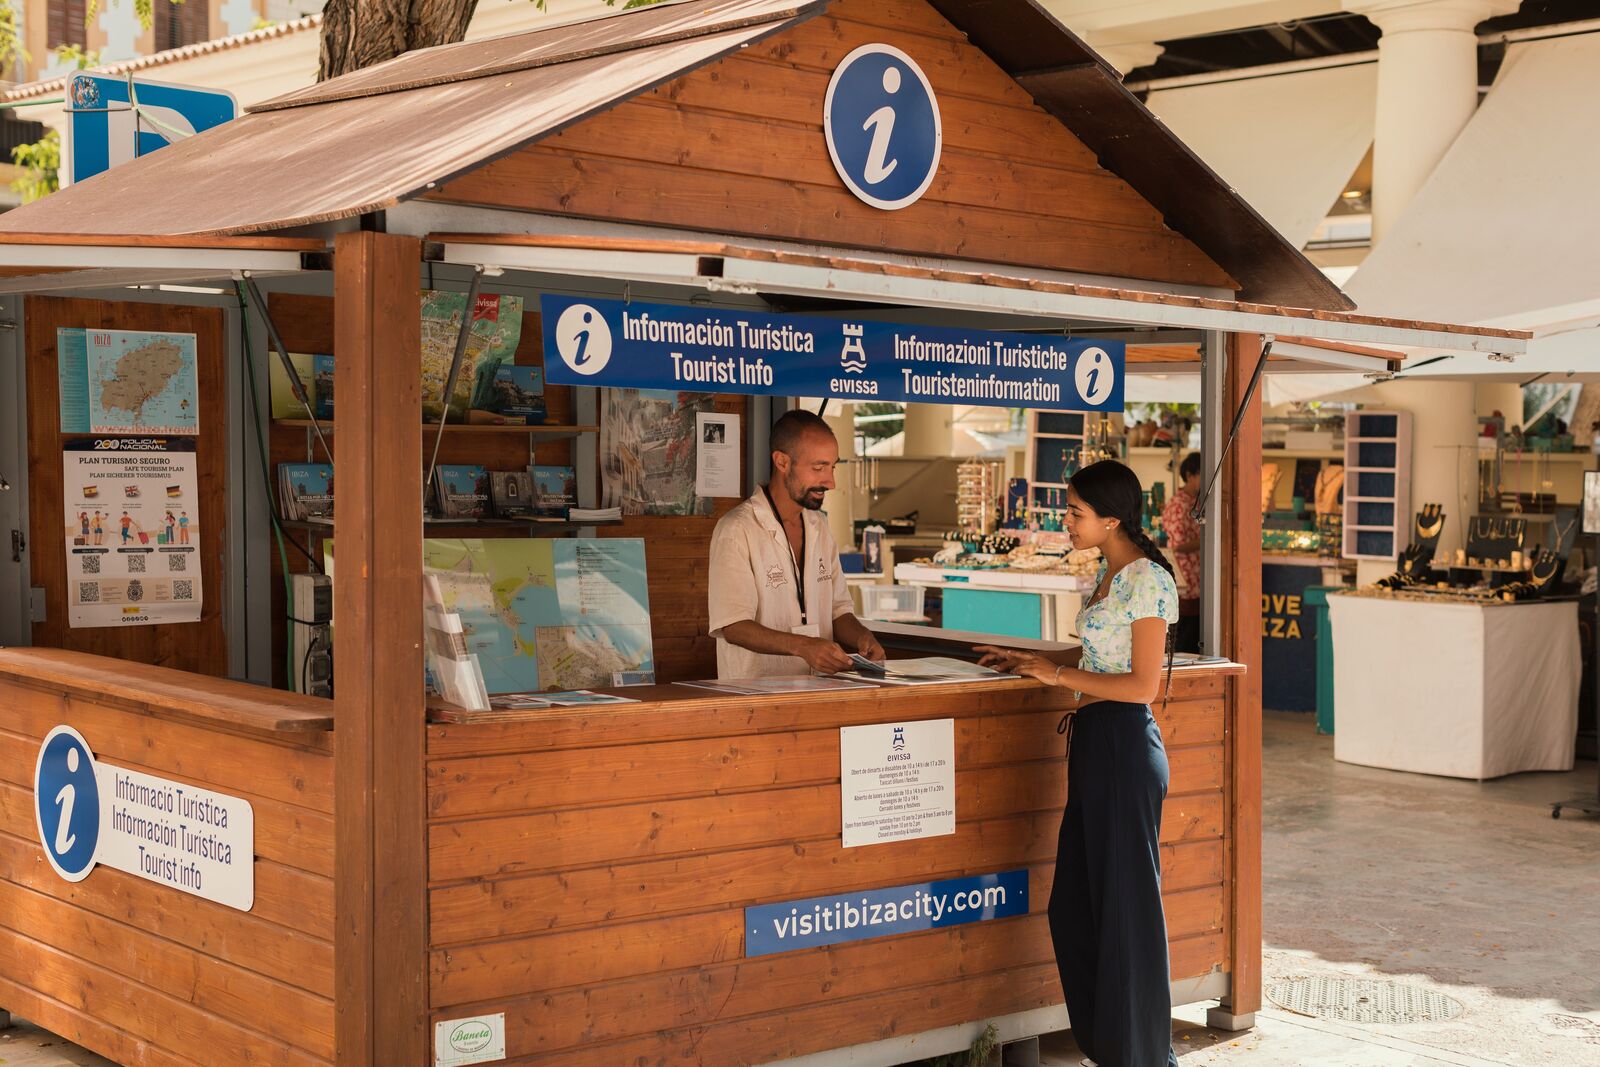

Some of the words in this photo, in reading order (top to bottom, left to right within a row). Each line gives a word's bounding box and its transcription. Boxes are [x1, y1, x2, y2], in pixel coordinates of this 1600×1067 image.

[623, 312, 734, 348] Información
[737, 321, 814, 353] Turística
[671, 352, 736, 384] Tourist
[740, 357, 774, 386] Info
[895, 334, 990, 366] Informazioni
[994, 342, 1067, 370] Turistiche
[830, 379, 878, 395] eivissa
[902, 368, 1060, 402] Touristeninformation
[94, 425, 197, 433] www.ibiza.travel
[1262, 594, 1301, 615] OVE
[1262, 618, 1301, 639] IZA
[887, 753, 911, 761] eivissa
[115, 773, 173, 814] Informació
[176, 789, 228, 829] Turística
[112, 805, 177, 848] Información
[180, 825, 232, 865] Turística
[139, 846, 178, 883] Tourist
[180, 859, 202, 890] info
[773, 885, 1006, 939] visitibizacity.com
[453, 1030, 489, 1042] Baneta
